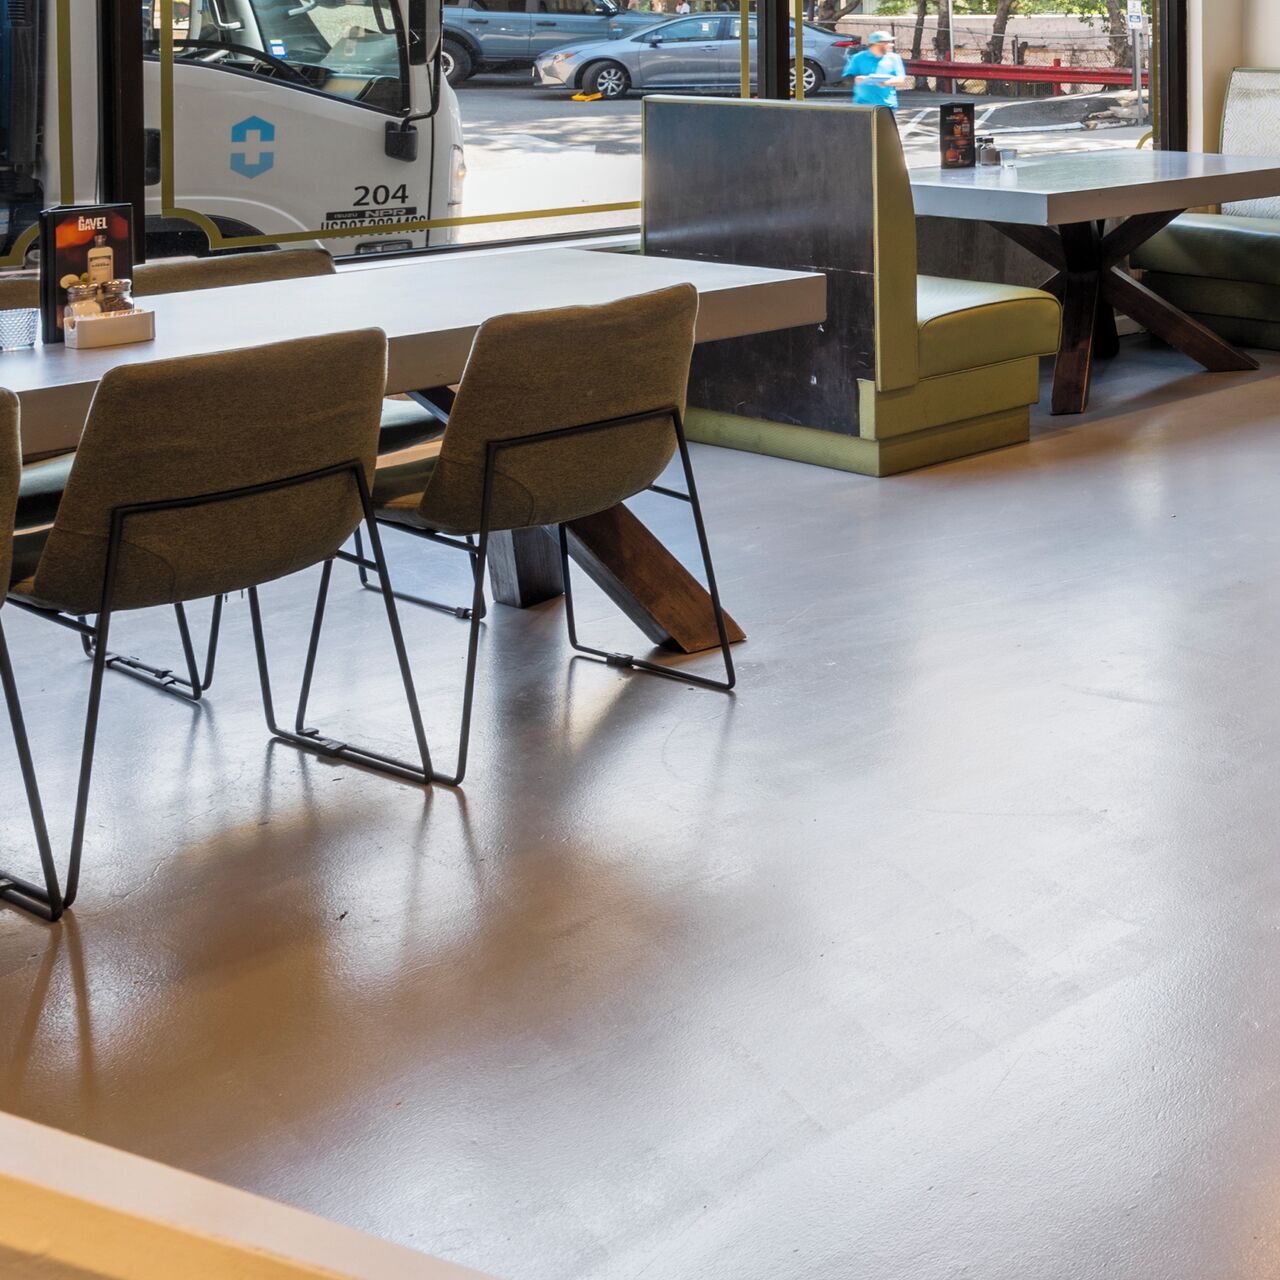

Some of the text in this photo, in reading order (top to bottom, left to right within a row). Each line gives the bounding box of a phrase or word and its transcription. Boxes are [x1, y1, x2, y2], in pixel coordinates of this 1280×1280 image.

[353, 184, 409, 206] 204
[365, 208, 407, 218] NPR
[78, 217, 108, 231] GAVEL
